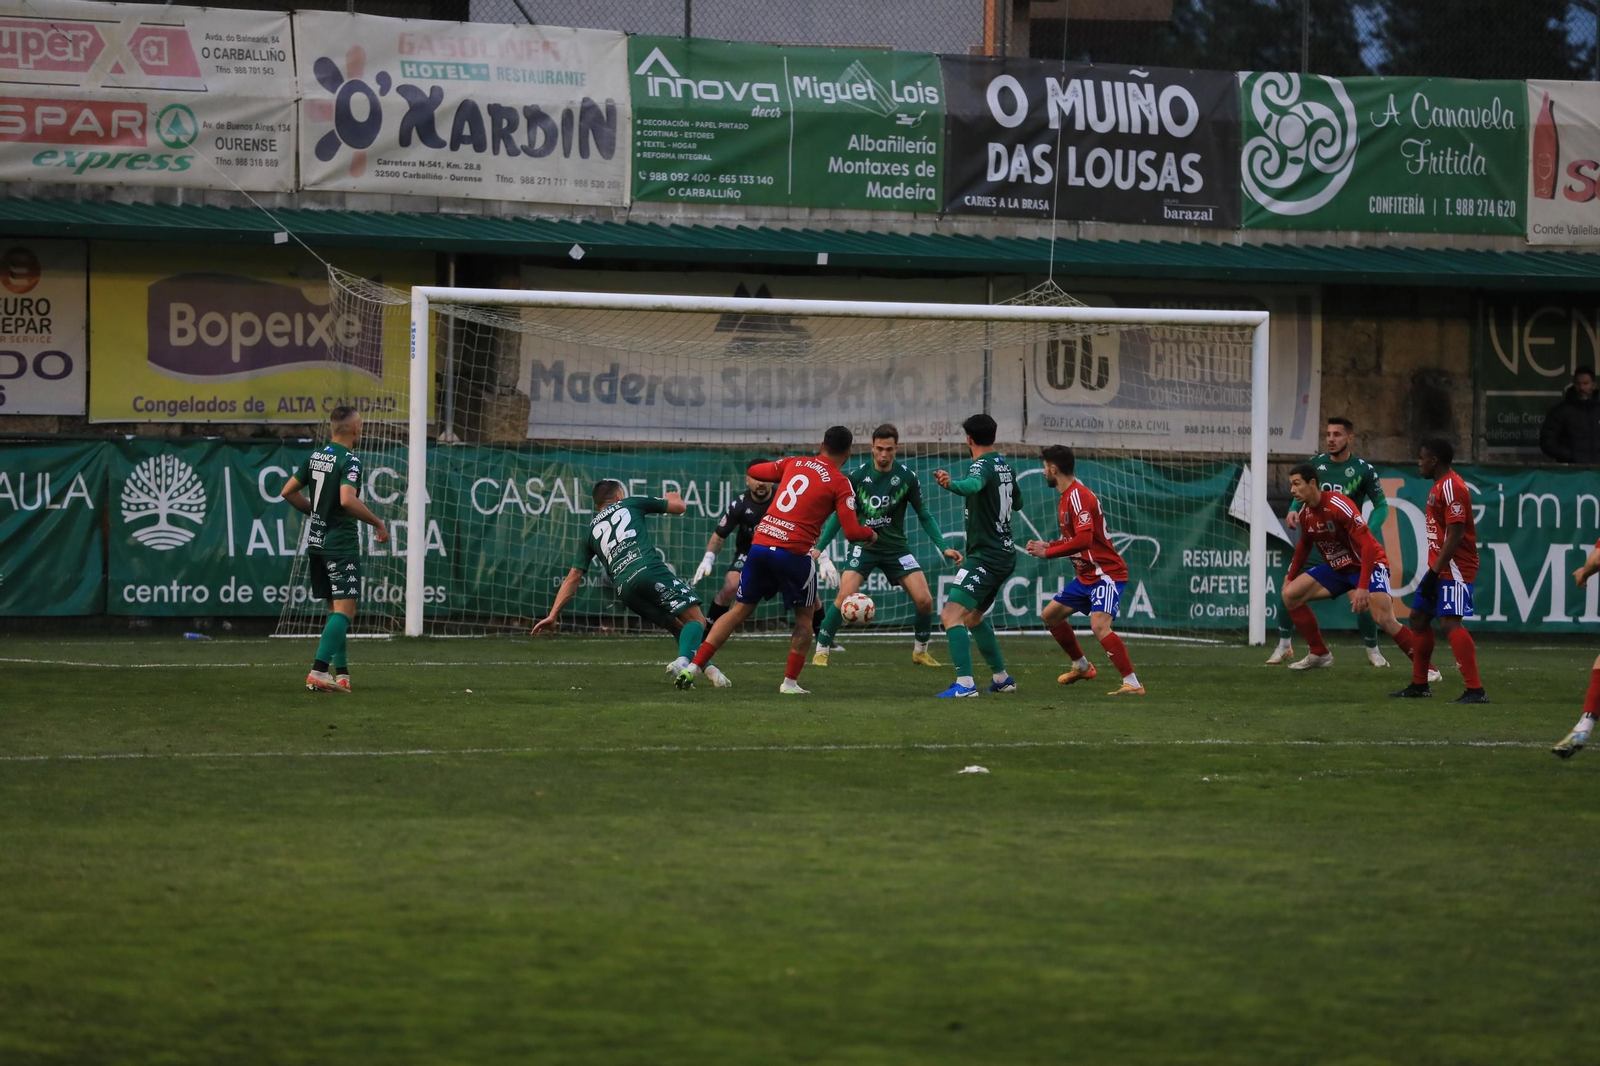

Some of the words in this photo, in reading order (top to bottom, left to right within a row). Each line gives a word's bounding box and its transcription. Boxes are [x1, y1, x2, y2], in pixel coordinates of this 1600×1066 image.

[205, 33, 223, 42] Avda.
[226, 34, 235, 42] do
[202, 48, 210, 59] O
[213, 46, 286, 62] CARBALLIÑO
[215, 65, 232, 74] Tfno.
[234, 66, 246, 75] 988
[248, 67, 260, 75] 701
[263, 67, 275, 75] 543
[497, 66, 587, 87] RESTAURANTE
[647, 72, 779, 102] innova
[793, 76, 878, 104] Miguel
[891, 80, 939, 104] Lois
[751, 104, 783, 118] decor
[986, 74, 1029, 129] O
[1045, 69, 1200, 138] MUIÑO
[1370, 93, 1401, 127] A
[1411, 92, 1516, 130] Canavela
[0, 105, 143, 139] SPAR
[203, 121, 213, 130] Av.
[215, 122, 225, 131] de
[226, 121, 253, 132] Buenos
[254, 123, 275, 133] Aires,
[277, 124, 291, 133] 134
[643, 119, 689, 128] DECORACIÓN
[695, 121, 717, 129] PAPEL
[718, 122, 749, 130] PINTADO
[643, 130, 679, 138] CORTINAS
[684, 132, 715, 140] ESTORES
[215, 137, 277, 152] OURENSE
[643, 141, 666, 149] TEXTIL
[848, 134, 936, 155] Albañilería
[32, 149, 195, 175] express
[215, 156, 233, 166] Tfno.
[235, 157, 248, 166] 988
[250, 158, 262, 167] 318
[265, 159, 279, 168] 889
[377, 158, 416, 168] Carretera
[418, 160, 444, 170] N-541,
[446, 161, 462, 170] Km.
[464, 162, 481, 171] 28.8
[643, 152, 676, 160] REFORMA
[677, 153, 712, 161] INTEGRAL
[1401, 138, 1488, 175] Fritida
[828, 156, 909, 177] Montaxes
[915, 160, 936, 178] de
[986, 142, 1054, 185] DAS
[1067, 146, 1204, 194] LOUSAS
[374, 170, 400, 179] 32500
[402, 170, 443, 181] Carballiño
[450, 174, 483, 183] Ourense
[496, 174, 516, 184] Tfno.
[520, 176, 535, 185] 988
[537, 177, 552, 186] 271
[574, 179, 588, 188] 988
[590, 180, 604, 189] 530
[649, 172, 668, 181] 988
[670, 172, 689, 182] 092
[692, 173, 710, 183] 400
[719, 174, 737, 184] 665
[739, 175, 754, 184] 133
[757, 176, 774, 185] 140
[668, 187, 676, 196] O
[678, 187, 741, 199] CARBALLIÑO
[866, 181, 936, 201] Madeira
[964, 195, 997, 208] CARNES
[999, 197, 1006, 208] A
[1008, 197, 1020, 209] LA
[1022, 198, 1050, 211] BRASA
[1369, 193, 1425, 215] CONFITERÍA
[1456, 198, 1474, 217] 988
[1477, 199, 1495, 217] 274
[1497, 200, 1516, 218] 620
[1163, 206, 1214, 221] barazal
[1533, 223, 1564, 235] Conde
[10, 336, 52, 344] SERVICE
[530, 359, 707, 408] Maderas
[133, 395, 237, 417] Congelados
[243, 396, 265, 413] de
[277, 397, 316, 413] ALTA
[1043, 415, 1104, 430] EDIFICACIÓN
[1108, 419, 1114, 429] Y
[1117, 420, 1143, 430] OBRA
[1146, 420, 1171, 431] CIVIL
[1498, 412, 1520, 424] Calle
[1200, 426, 1215, 435] 214
[1269, 427, 1283, 436] 909
[804, 460, 831, 483] ROMERO
[311, 471, 326, 512] 7
[471, 477, 591, 515] CASAL
[776, 474, 810, 513] 8
[763, 514, 796, 531] ALVAREZ
[592, 508, 637, 565] 22
[1183, 550, 1282, 567] RESTAURATE
[124, 579, 209, 603] centro
[220, 576, 254, 603] de
[1190, 575, 1276, 594] CAFETEA
[1442, 585, 1456, 603] 11
